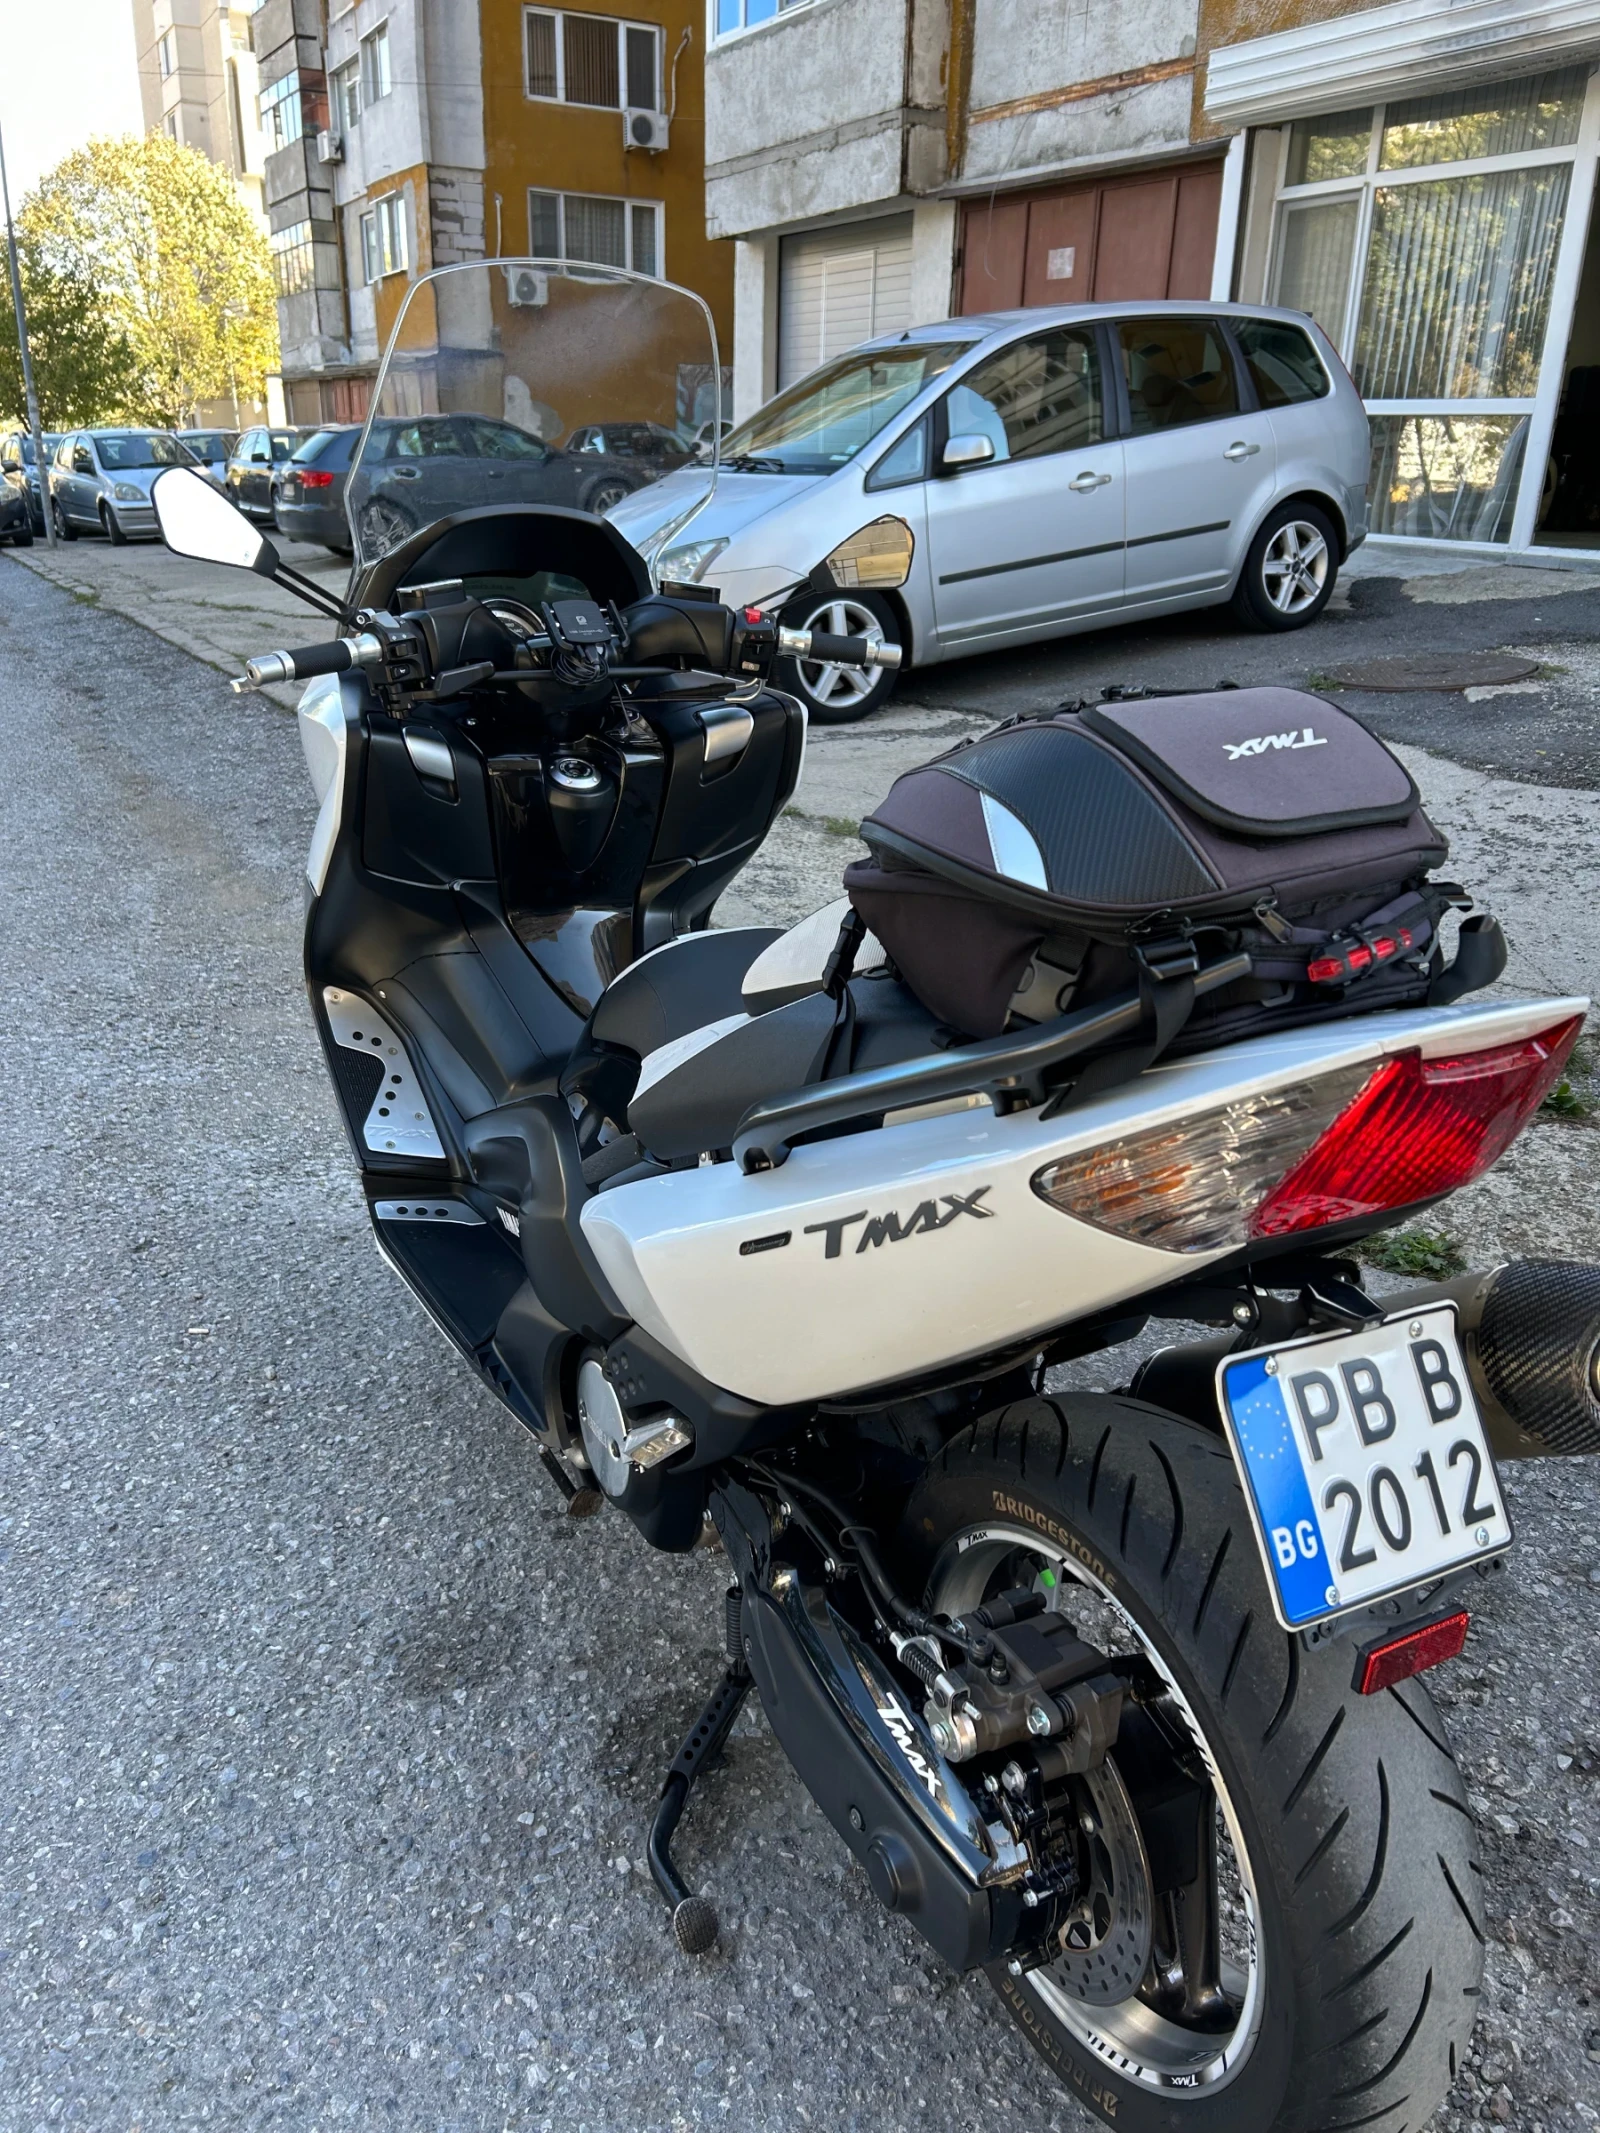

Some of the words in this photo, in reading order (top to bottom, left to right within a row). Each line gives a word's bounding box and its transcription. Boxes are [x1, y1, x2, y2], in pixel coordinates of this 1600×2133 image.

[1222, 728, 1328, 760] TMAX
[803, 1185, 994, 1259] TMAX
[1289, 1357, 1397, 1462] PB
[1410, 1338, 1462, 1425] B
[992, 1490, 1118, 1591] BRIDGESTONE
[1271, 1519, 1319, 1569] BG
[1324, 1439, 1496, 1574] 2012
[876, 1691, 942, 1798] TMAX
